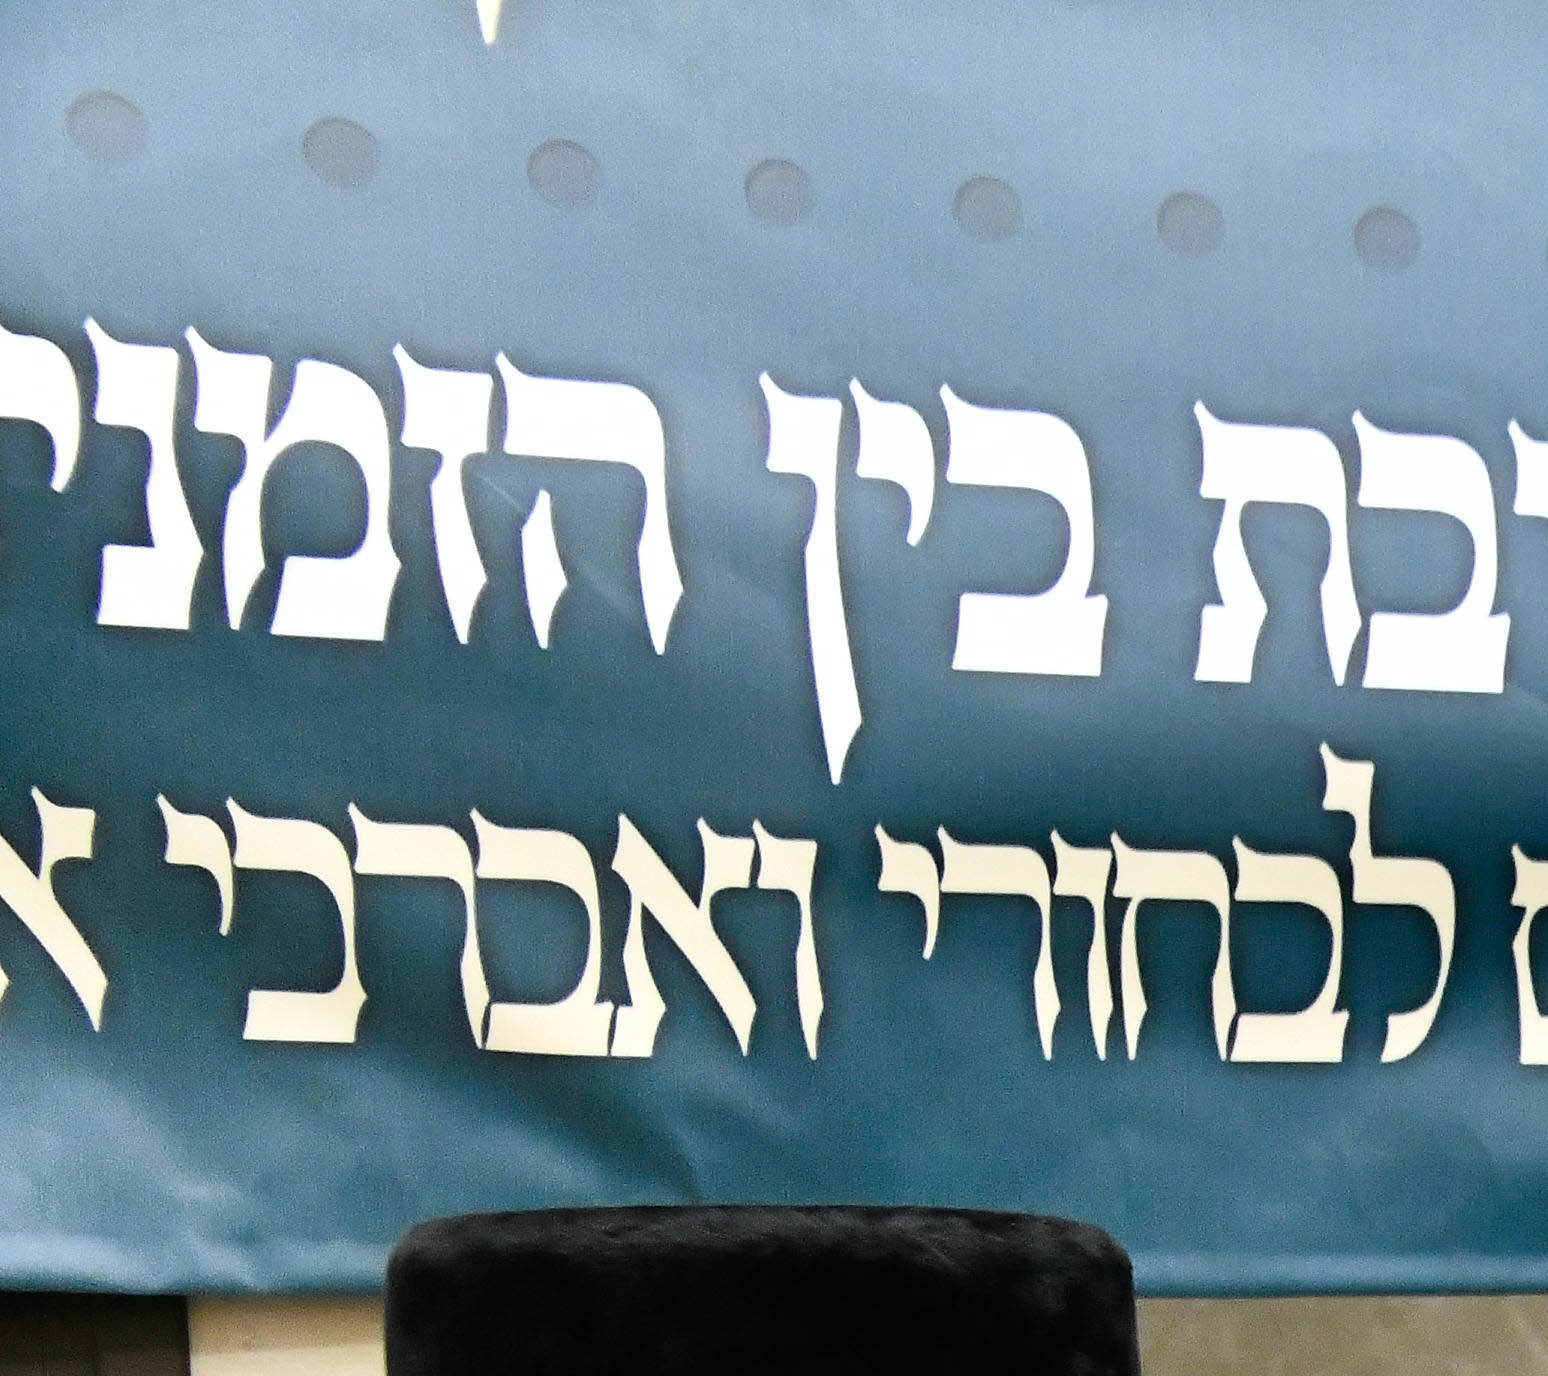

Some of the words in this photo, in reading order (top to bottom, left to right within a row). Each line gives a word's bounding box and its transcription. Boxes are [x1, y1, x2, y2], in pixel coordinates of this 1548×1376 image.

[759, 367, 1109, 786] בין
[156, 793, 825, 1061] ואברכי
[875, 742, 1458, 1064] לבחורי
